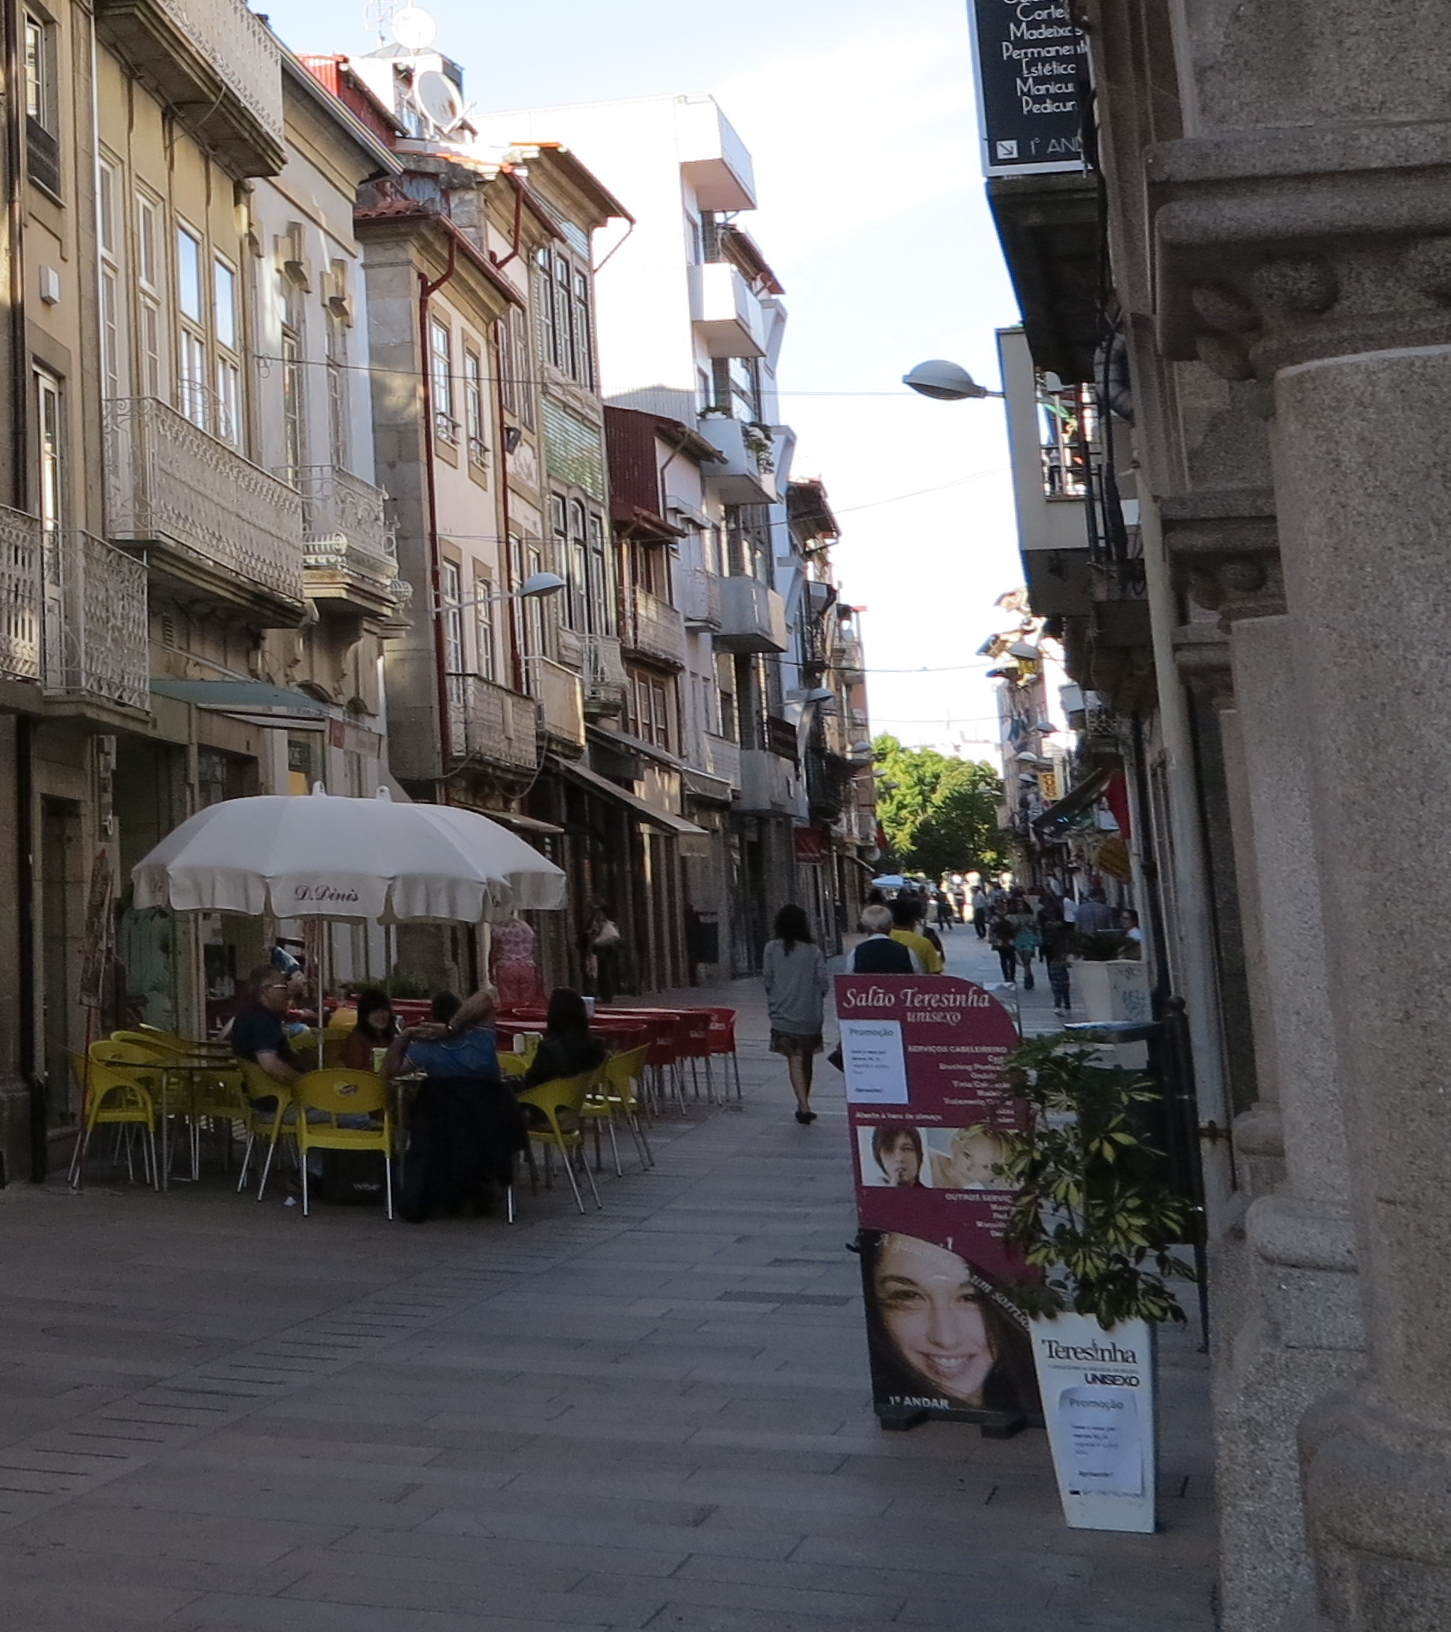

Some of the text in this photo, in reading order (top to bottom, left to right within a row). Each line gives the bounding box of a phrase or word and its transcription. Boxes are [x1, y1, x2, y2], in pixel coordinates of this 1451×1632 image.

[1002, 41, 1089, 60] Permanent
[1022, 96, 1078, 114] Pedicur
[1047, 136, 1083, 154] AND
[843, 985, 992, 1009] Salão Teresinha
[906, 1007, 961, 1026] unisexo
[1041, 1338, 1137, 1364] Teresinha
[1084, 1372, 1140, 1387] UNISEXO
[903, 1396, 950, 1411] ANDAR
[1069, 1397, 1124, 1411] Promoção
